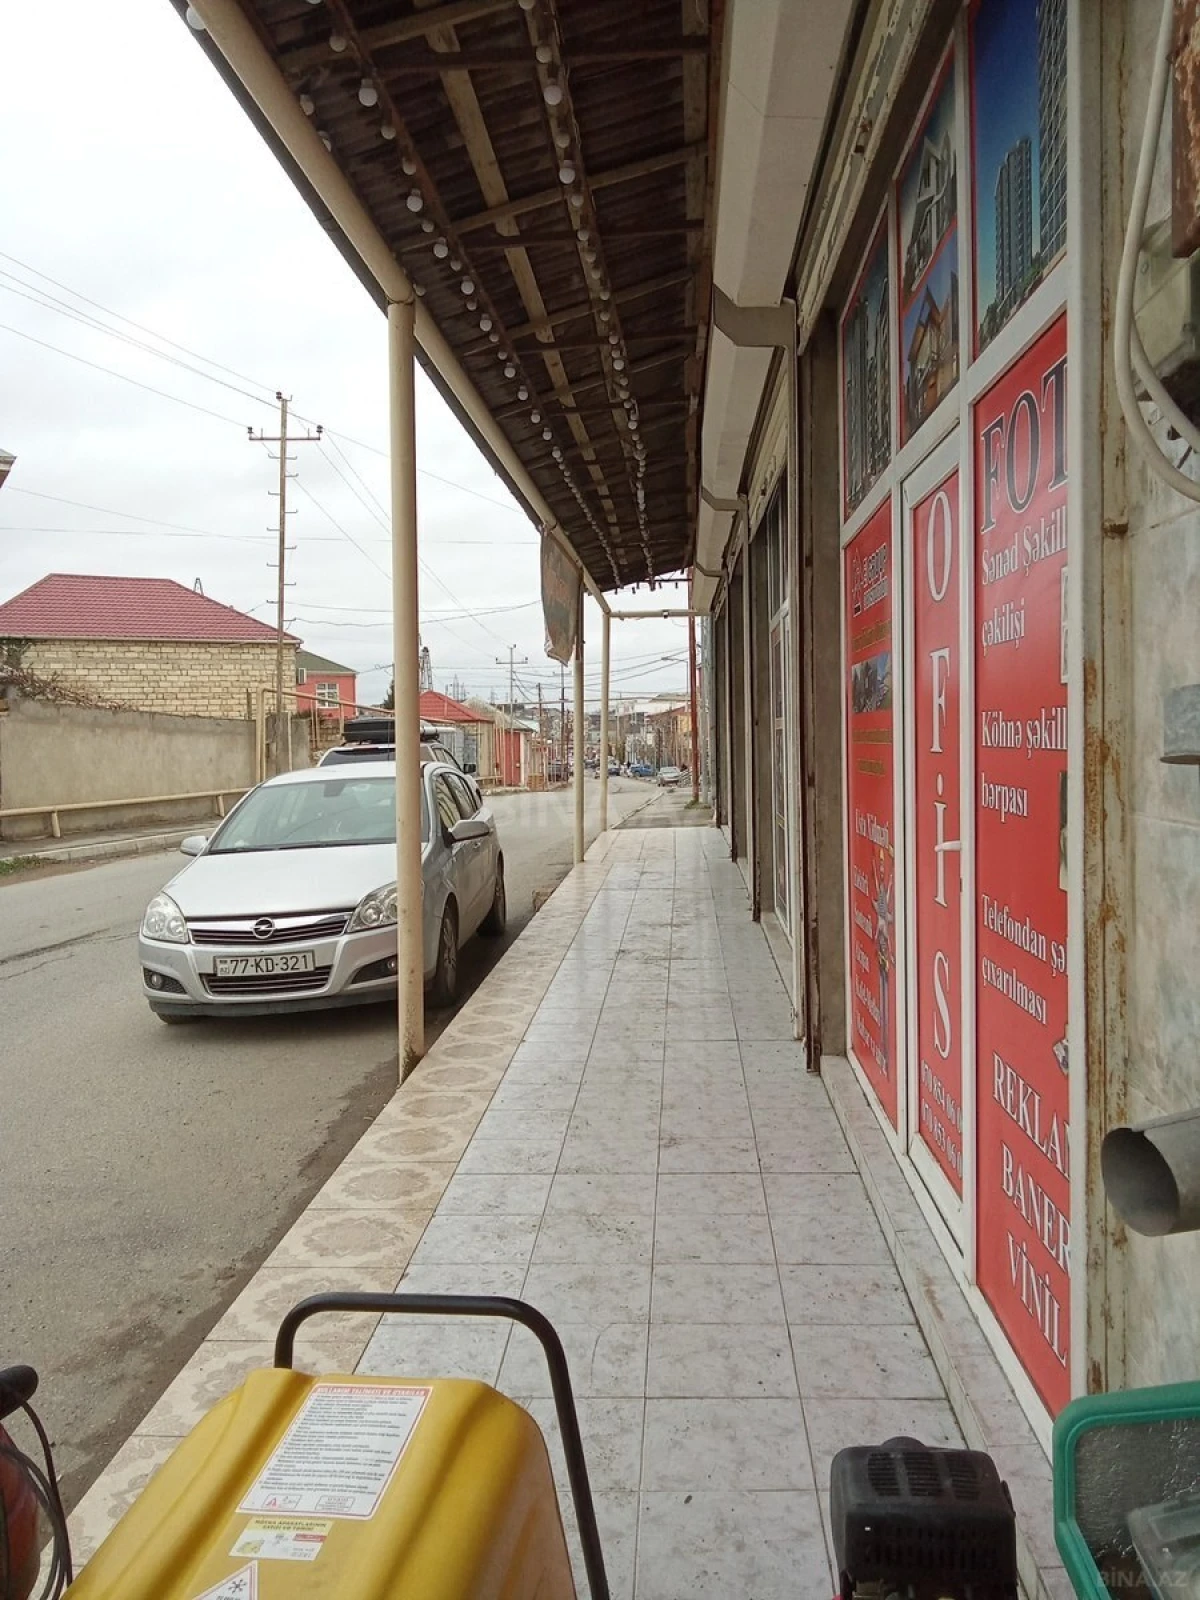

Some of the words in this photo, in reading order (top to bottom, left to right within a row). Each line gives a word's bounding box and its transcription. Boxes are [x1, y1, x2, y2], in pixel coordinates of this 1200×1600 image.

[982, 531, 1019, 586] Sənəd
[981, 597, 1025, 657] çəkilişi
[981, 709, 1022, 750] Köhnə
[981, 771, 1028, 824] bərpası
[981, 893, 1047, 962] Telefondan
[981, 954, 1047, 1027] çıxarılması
[1007, 1230, 1068, 1369] VİNİL
